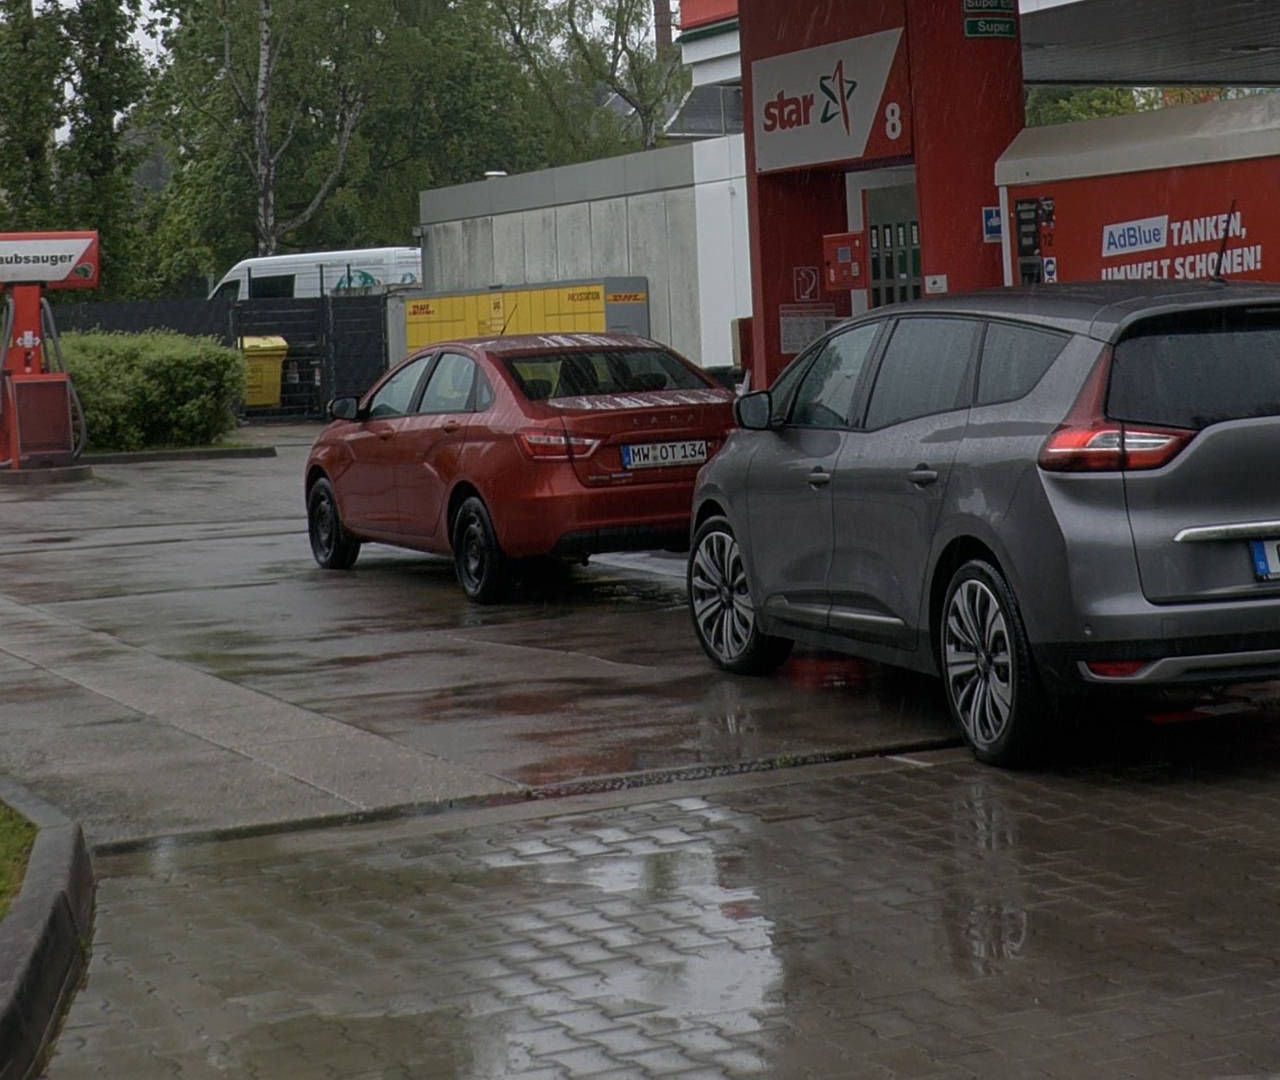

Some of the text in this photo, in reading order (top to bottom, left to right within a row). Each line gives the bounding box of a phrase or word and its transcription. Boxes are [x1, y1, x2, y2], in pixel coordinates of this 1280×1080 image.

[977, 20, 1010, 35] Super
[763, 89, 814, 132] star
[885, 102, 902, 140] 8
[1105, 211, 1247, 251] AdBlue TANKEN,
[631, 442, 706, 463] MW OT 134
